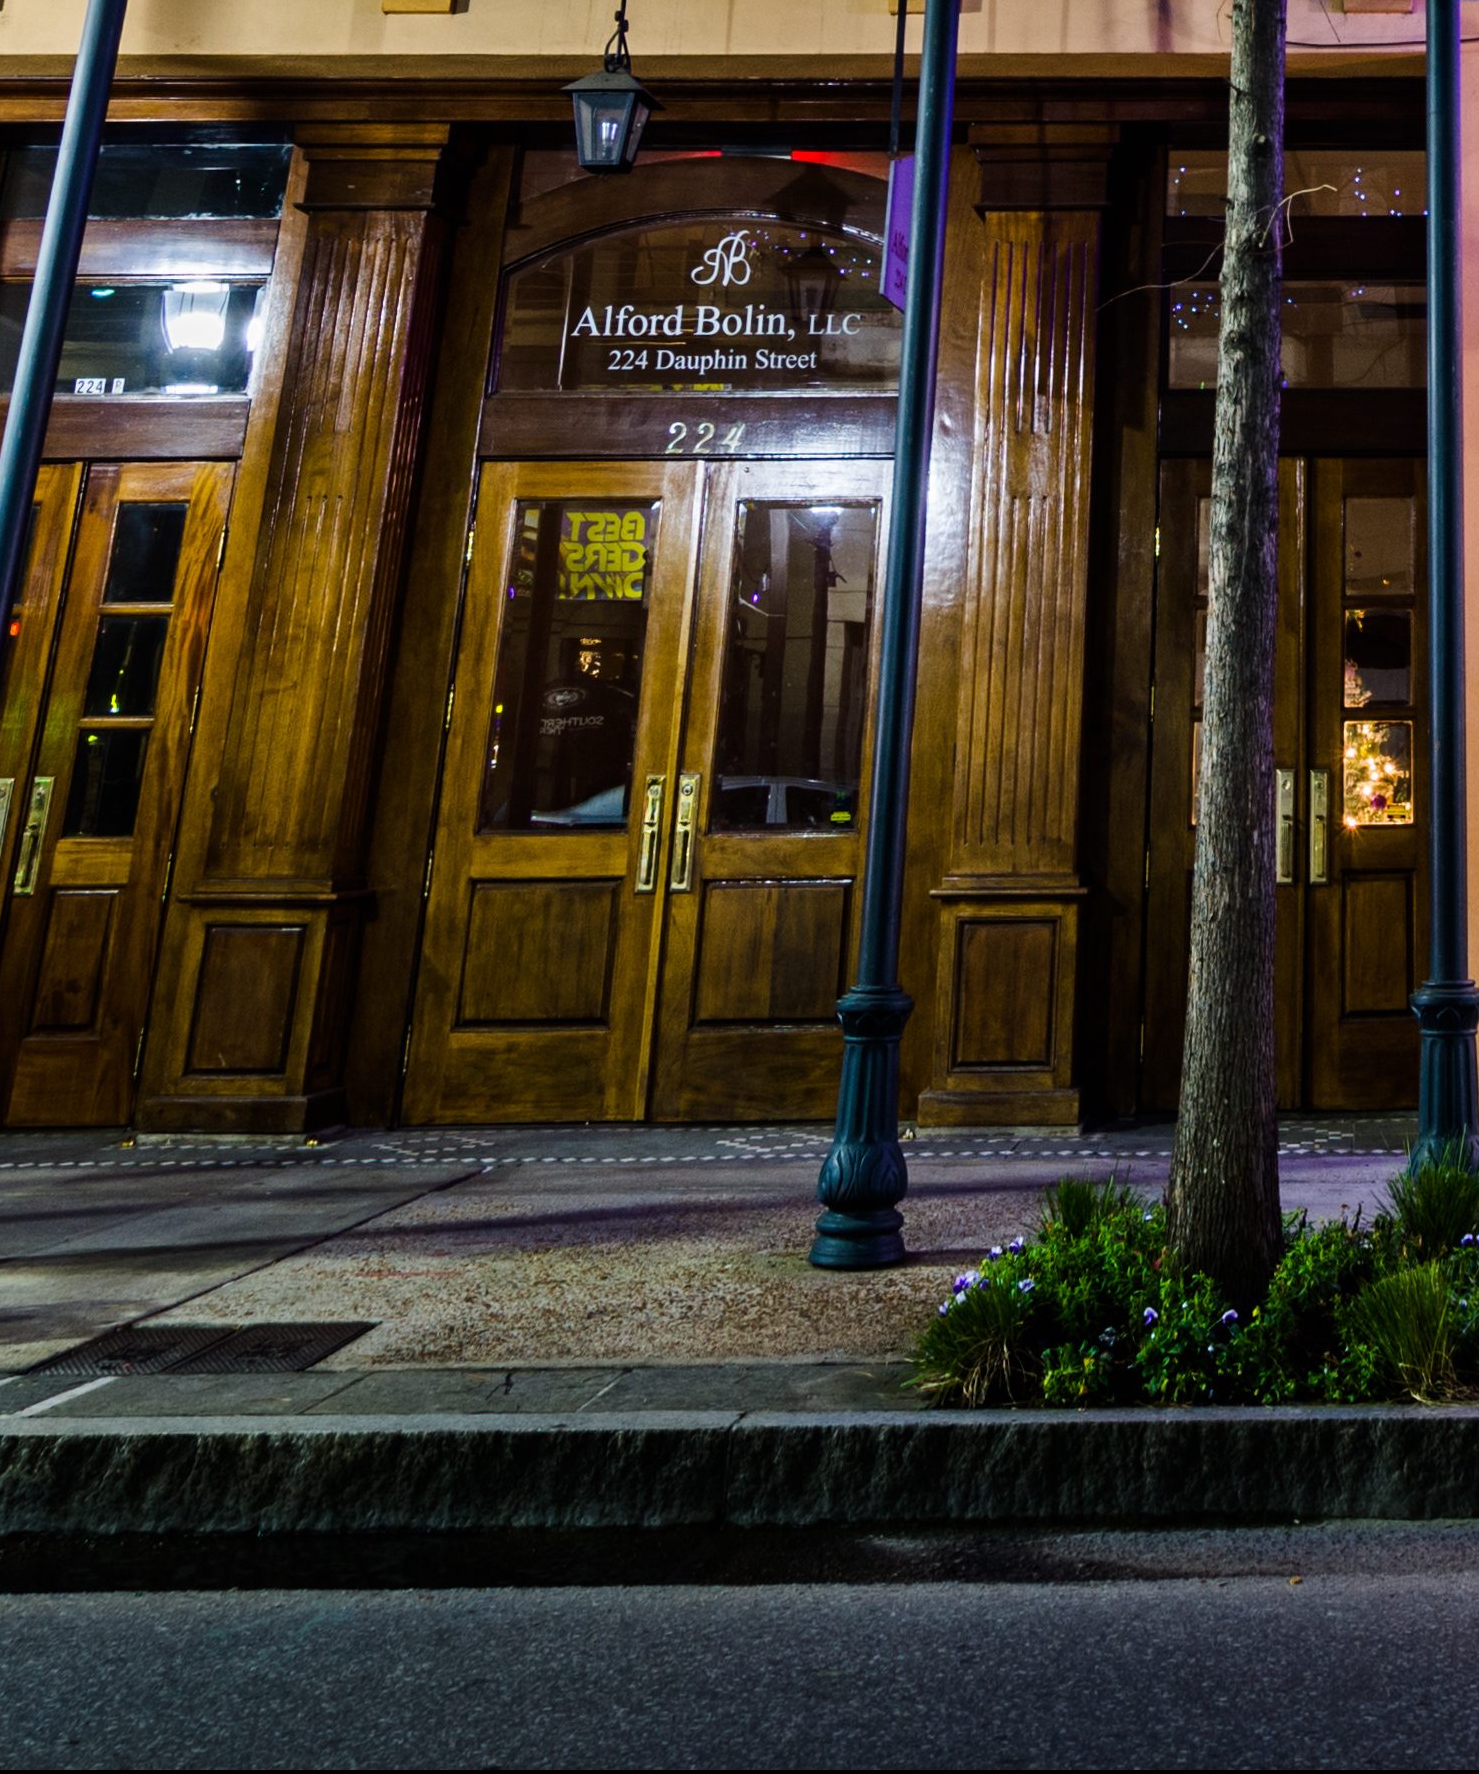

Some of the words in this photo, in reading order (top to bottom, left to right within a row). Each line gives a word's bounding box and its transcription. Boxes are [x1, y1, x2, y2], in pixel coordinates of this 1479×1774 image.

[571, 304, 684, 337] Alford
[693, 304, 797, 341] Bolin,
[808, 314, 861, 336] LLC
[607, 350, 648, 370] 224
[655, 349, 747, 375] Dauphin
[754, 349, 817, 370] Street
[76, 380, 104, 394] 224
[665, 422, 746, 454] 224
